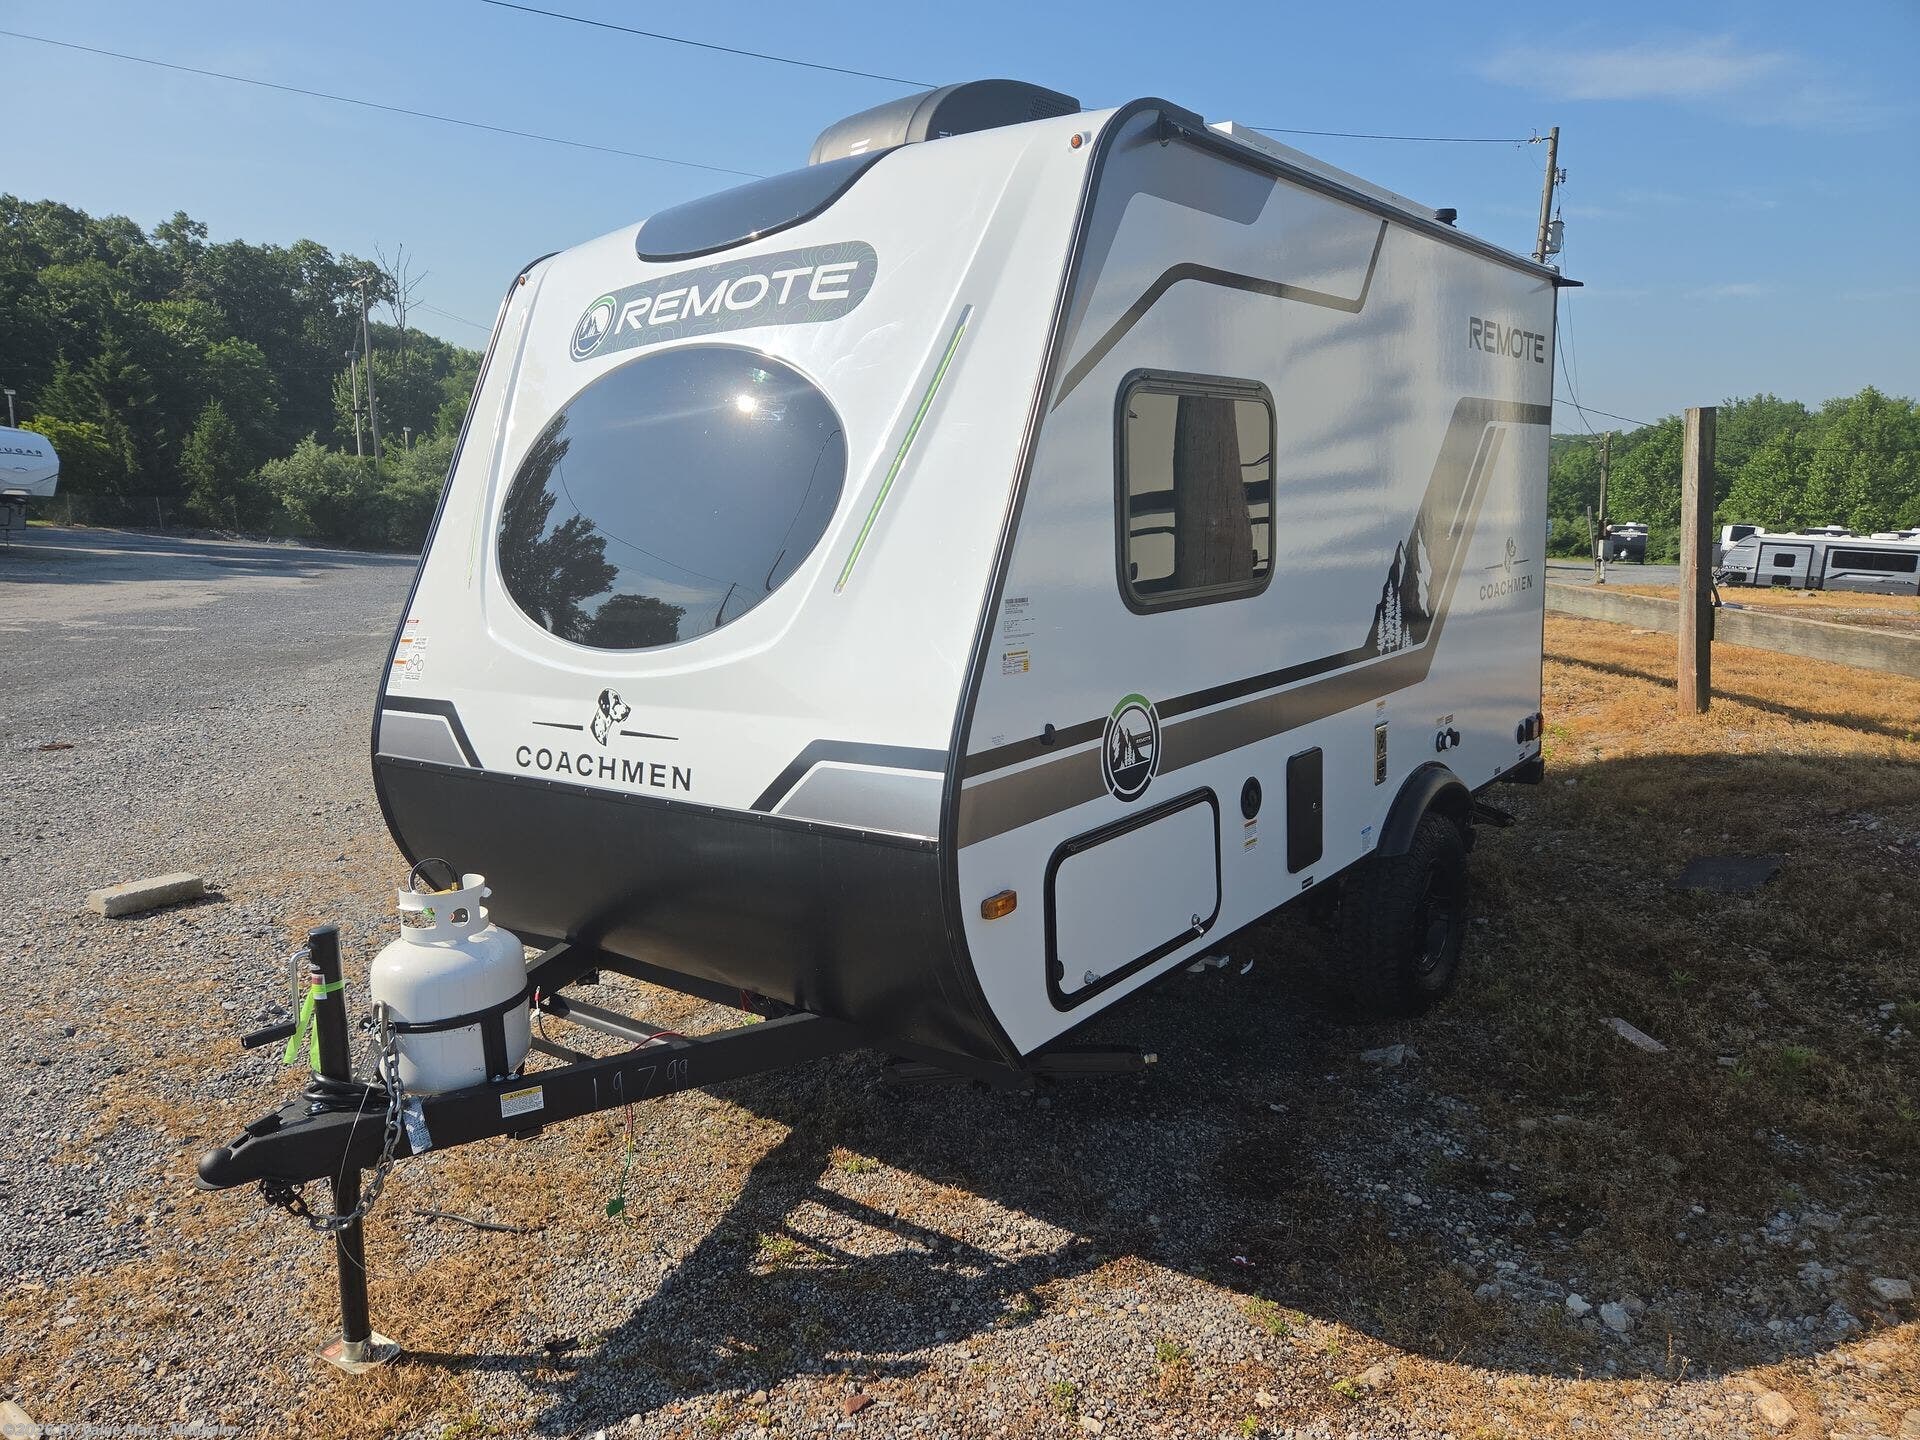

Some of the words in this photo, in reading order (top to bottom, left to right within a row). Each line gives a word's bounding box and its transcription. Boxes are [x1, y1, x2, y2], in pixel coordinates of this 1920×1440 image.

[614, 261, 859, 335] REMOTE
[1468, 315, 1545, 364] REMOTE
[0, 447, 42, 455] UGAR
[1479, 574, 1533, 602] COACHMEN
[515, 745, 692, 792] COACHMEN
